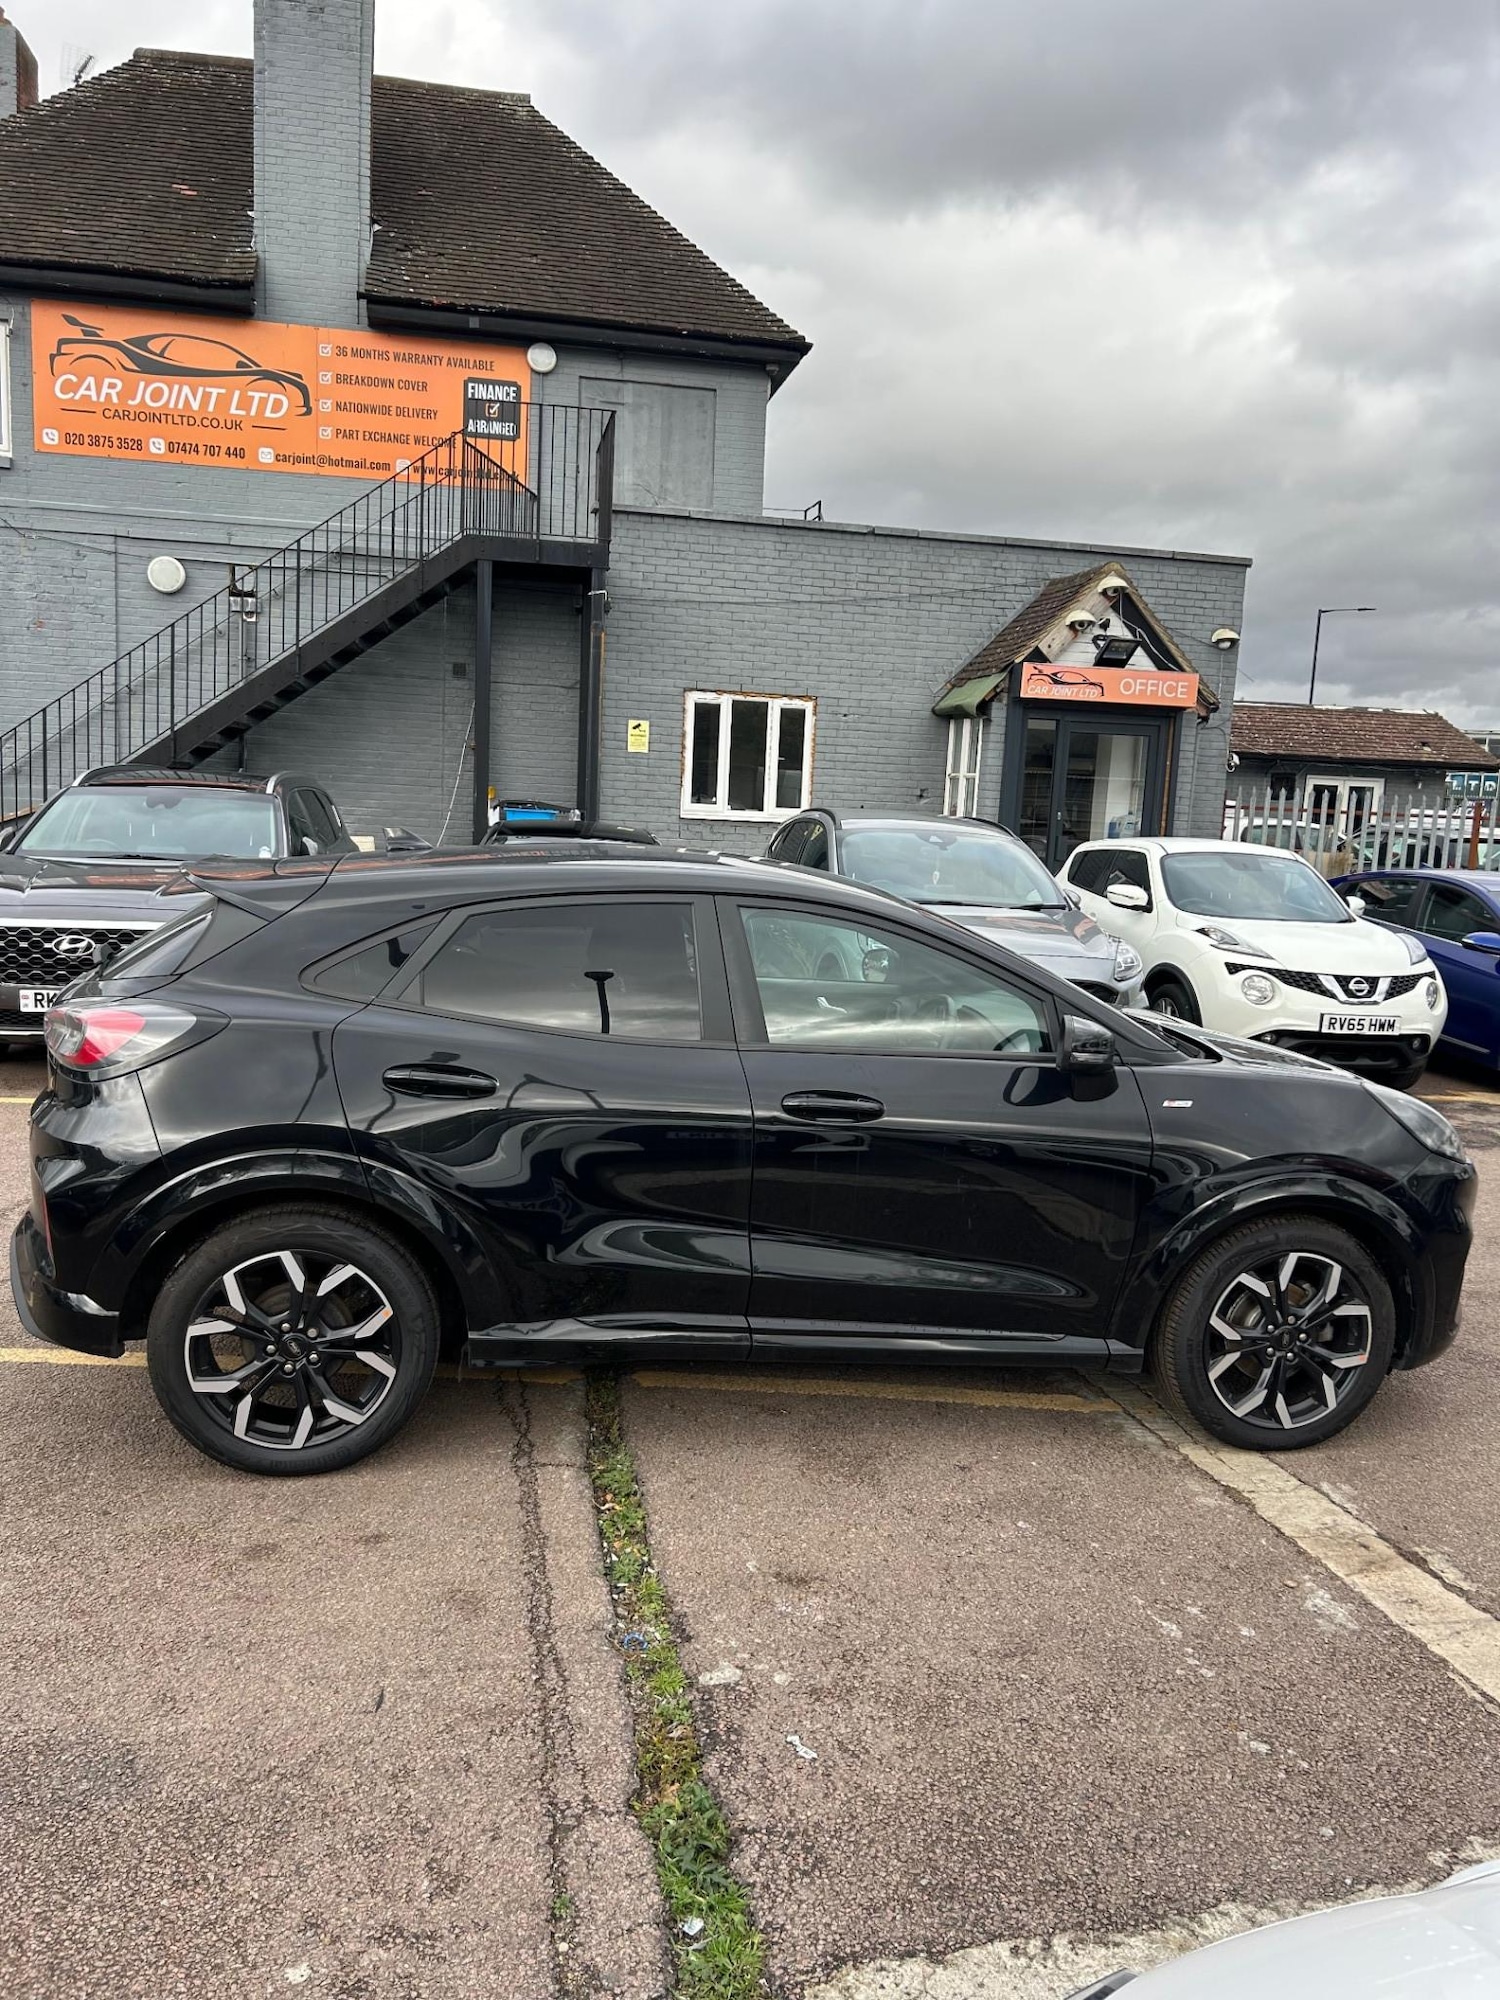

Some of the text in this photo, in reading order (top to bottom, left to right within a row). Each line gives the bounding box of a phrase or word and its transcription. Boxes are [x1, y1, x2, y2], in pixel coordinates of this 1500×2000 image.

[336, 346, 495, 372] 36 MONTHS WARRANTY AVAILABLE
[336, 373, 428, 392] BREAKDOWN COVER
[468, 382, 517, 402] FINANCE
[53, 374, 289, 419] CAR JOINT LTD
[102, 408, 243, 432] CARJOINTLTD.CO.UK
[336, 401, 438, 420] NATIONWIDE DELIVERY
[336, 428, 360, 440] PART
[363, 430, 410, 445] EXCHANGE
[468, 418, 516, 436] ARRANGED
[65, 432, 143, 452] 020 3875 3528
[168, 441, 246, 460] 07474 707 440
[276, 452, 390, 471] carjoint@hotmail.com
[1027, 684, 1098, 698] CAR JOINT LTD
[1120, 678, 1188, 698] OFFICE
[1328, 1017, 1396, 1032] RV65 HWM
